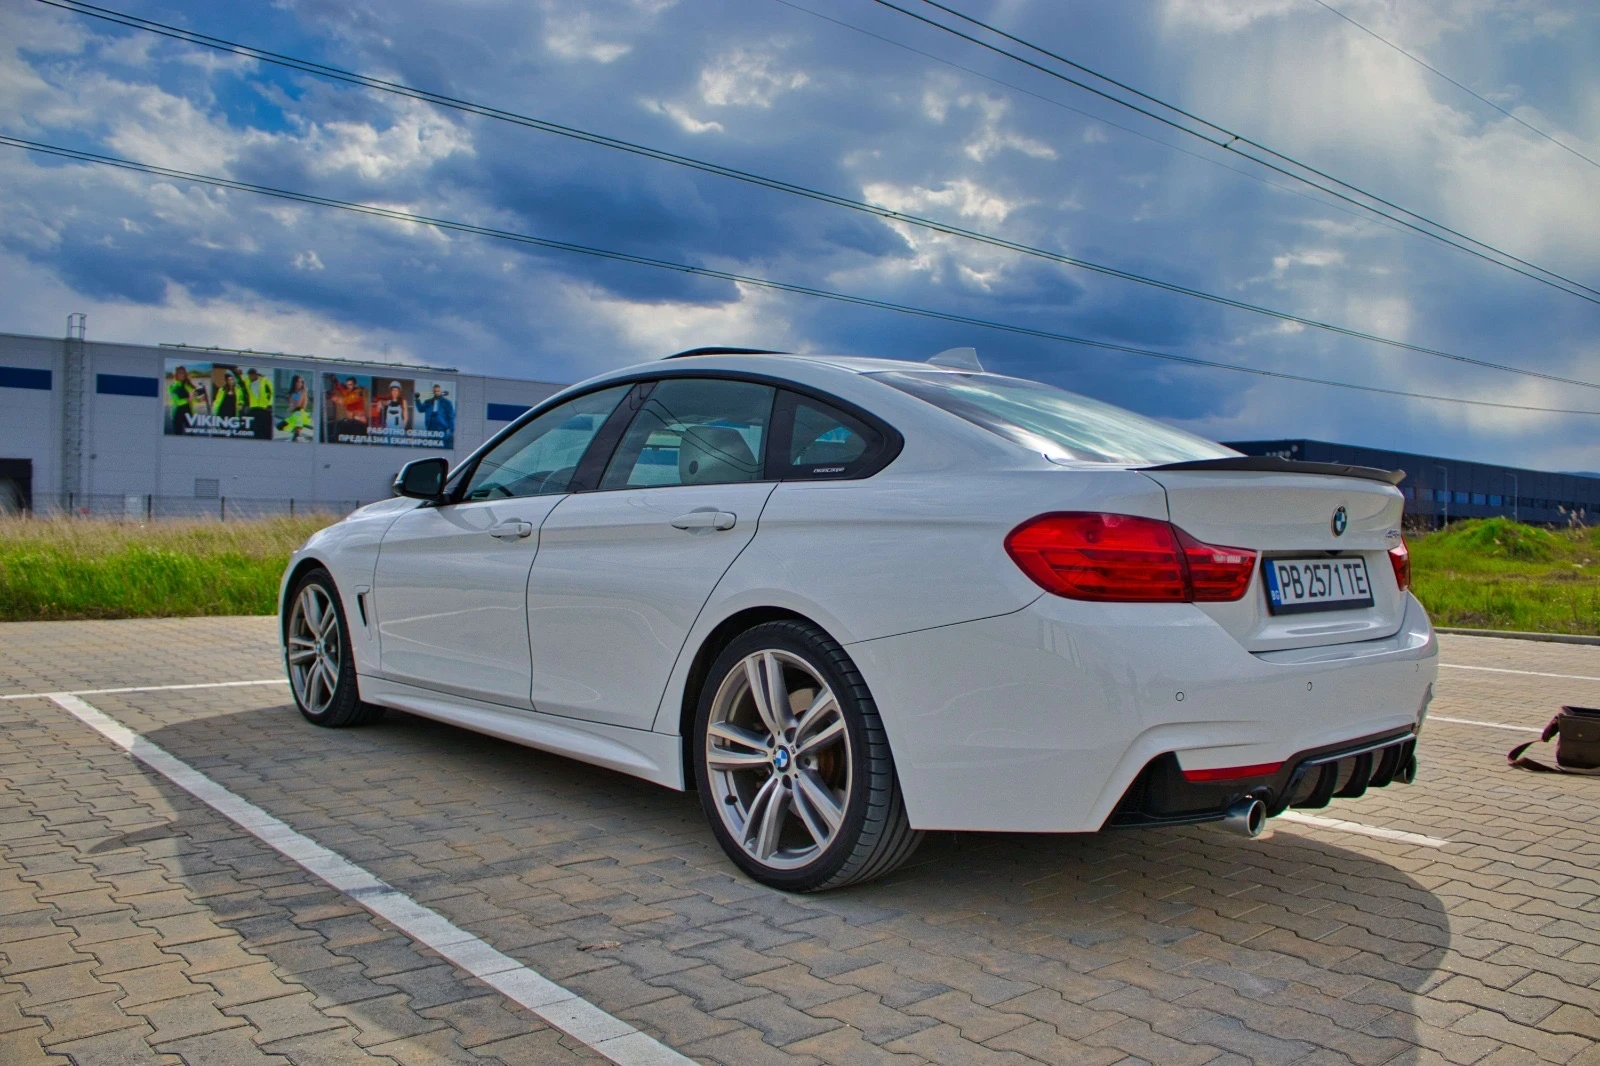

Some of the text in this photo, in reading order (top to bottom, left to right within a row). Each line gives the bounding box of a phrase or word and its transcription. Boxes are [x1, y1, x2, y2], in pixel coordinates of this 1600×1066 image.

[184, 428, 255, 437] www.viking-t.com
[366, 427, 445, 438] РАБОТНО ОБЛЕКЛО
[338, 434, 444, 447] ПРЕДПАЗНА ЕКИПИРОВКА
[1278, 563, 1367, 599] PB 2571 TE
[1271, 590, 1281, 601] BG
